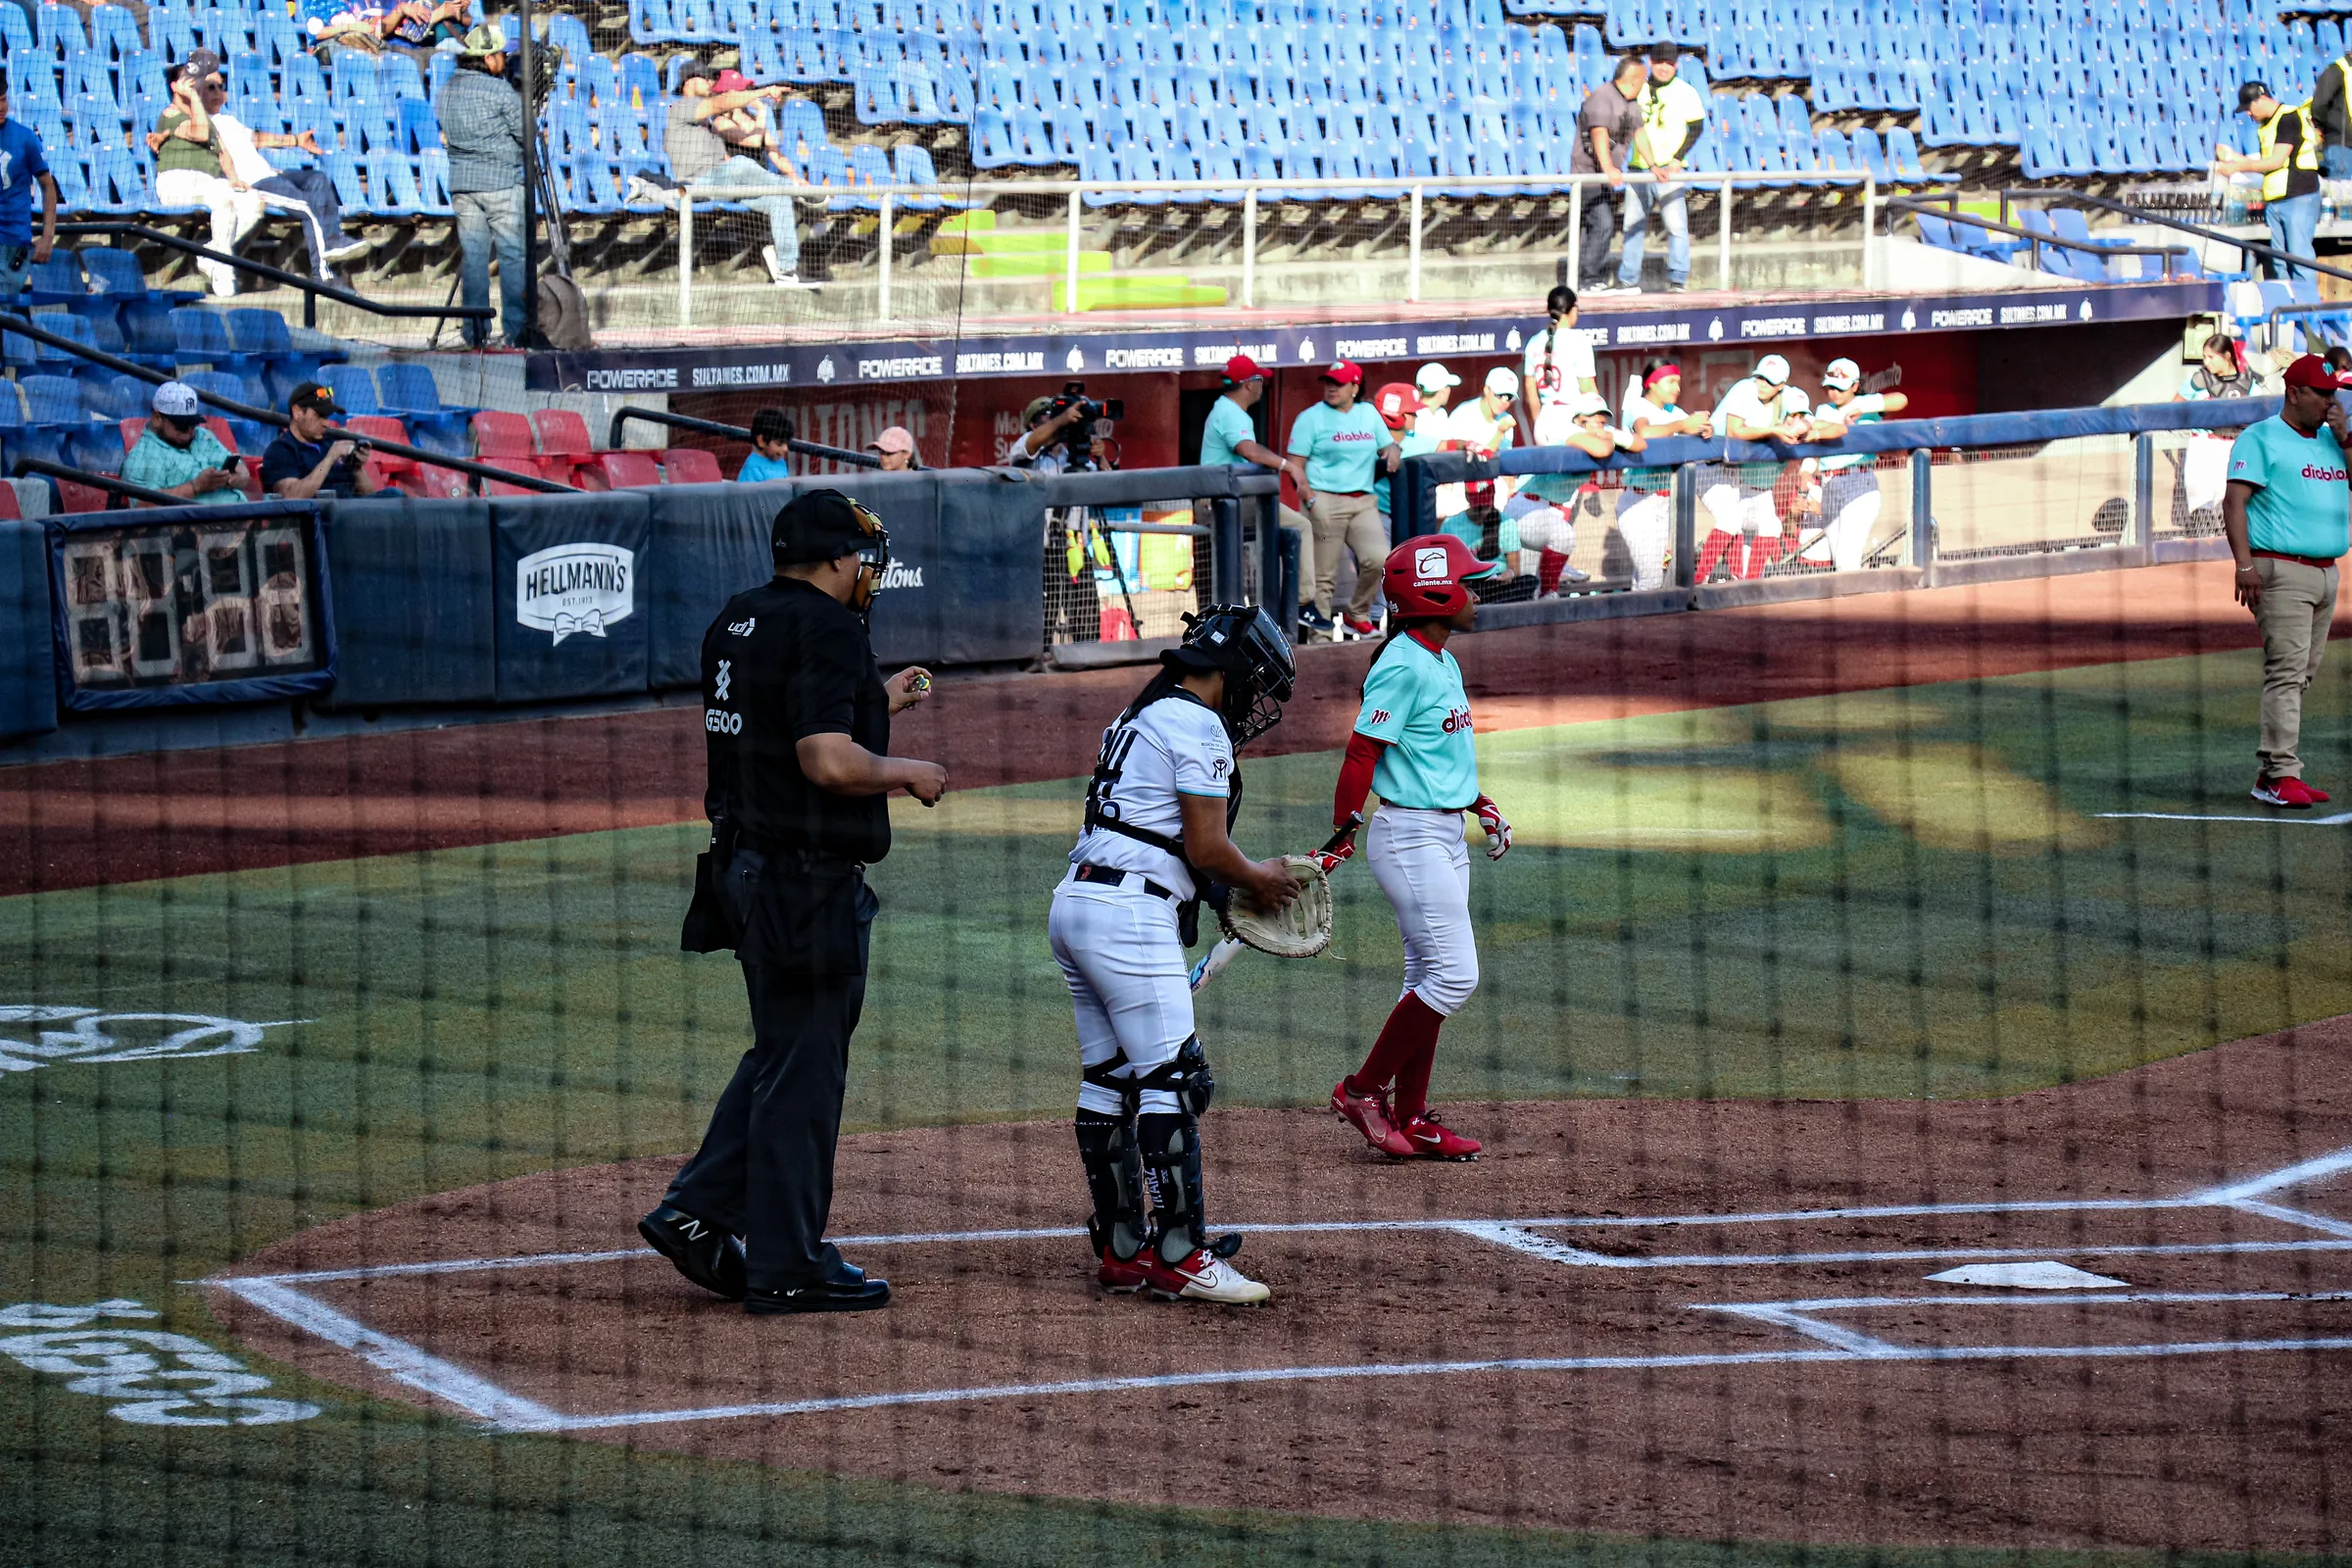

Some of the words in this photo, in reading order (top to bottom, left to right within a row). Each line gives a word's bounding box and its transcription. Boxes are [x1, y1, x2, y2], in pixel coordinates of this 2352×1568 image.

[1740, 318, 1806, 337] POWERADE
[1932, 308, 1993, 327] POWERADE
[1105, 348, 1184, 368] POWERADE
[1336, 338, 1408, 359] POWERADE
[587, 368, 678, 389] POWERADE
[692, 365, 790, 387] SULTANES.COM.MX
[858, 357, 943, 378] POWERADE
[525, 555, 626, 602] HELLMANN'S
[1413, 579, 1453, 588] caliente.mx
[706, 709, 743, 735] G500
